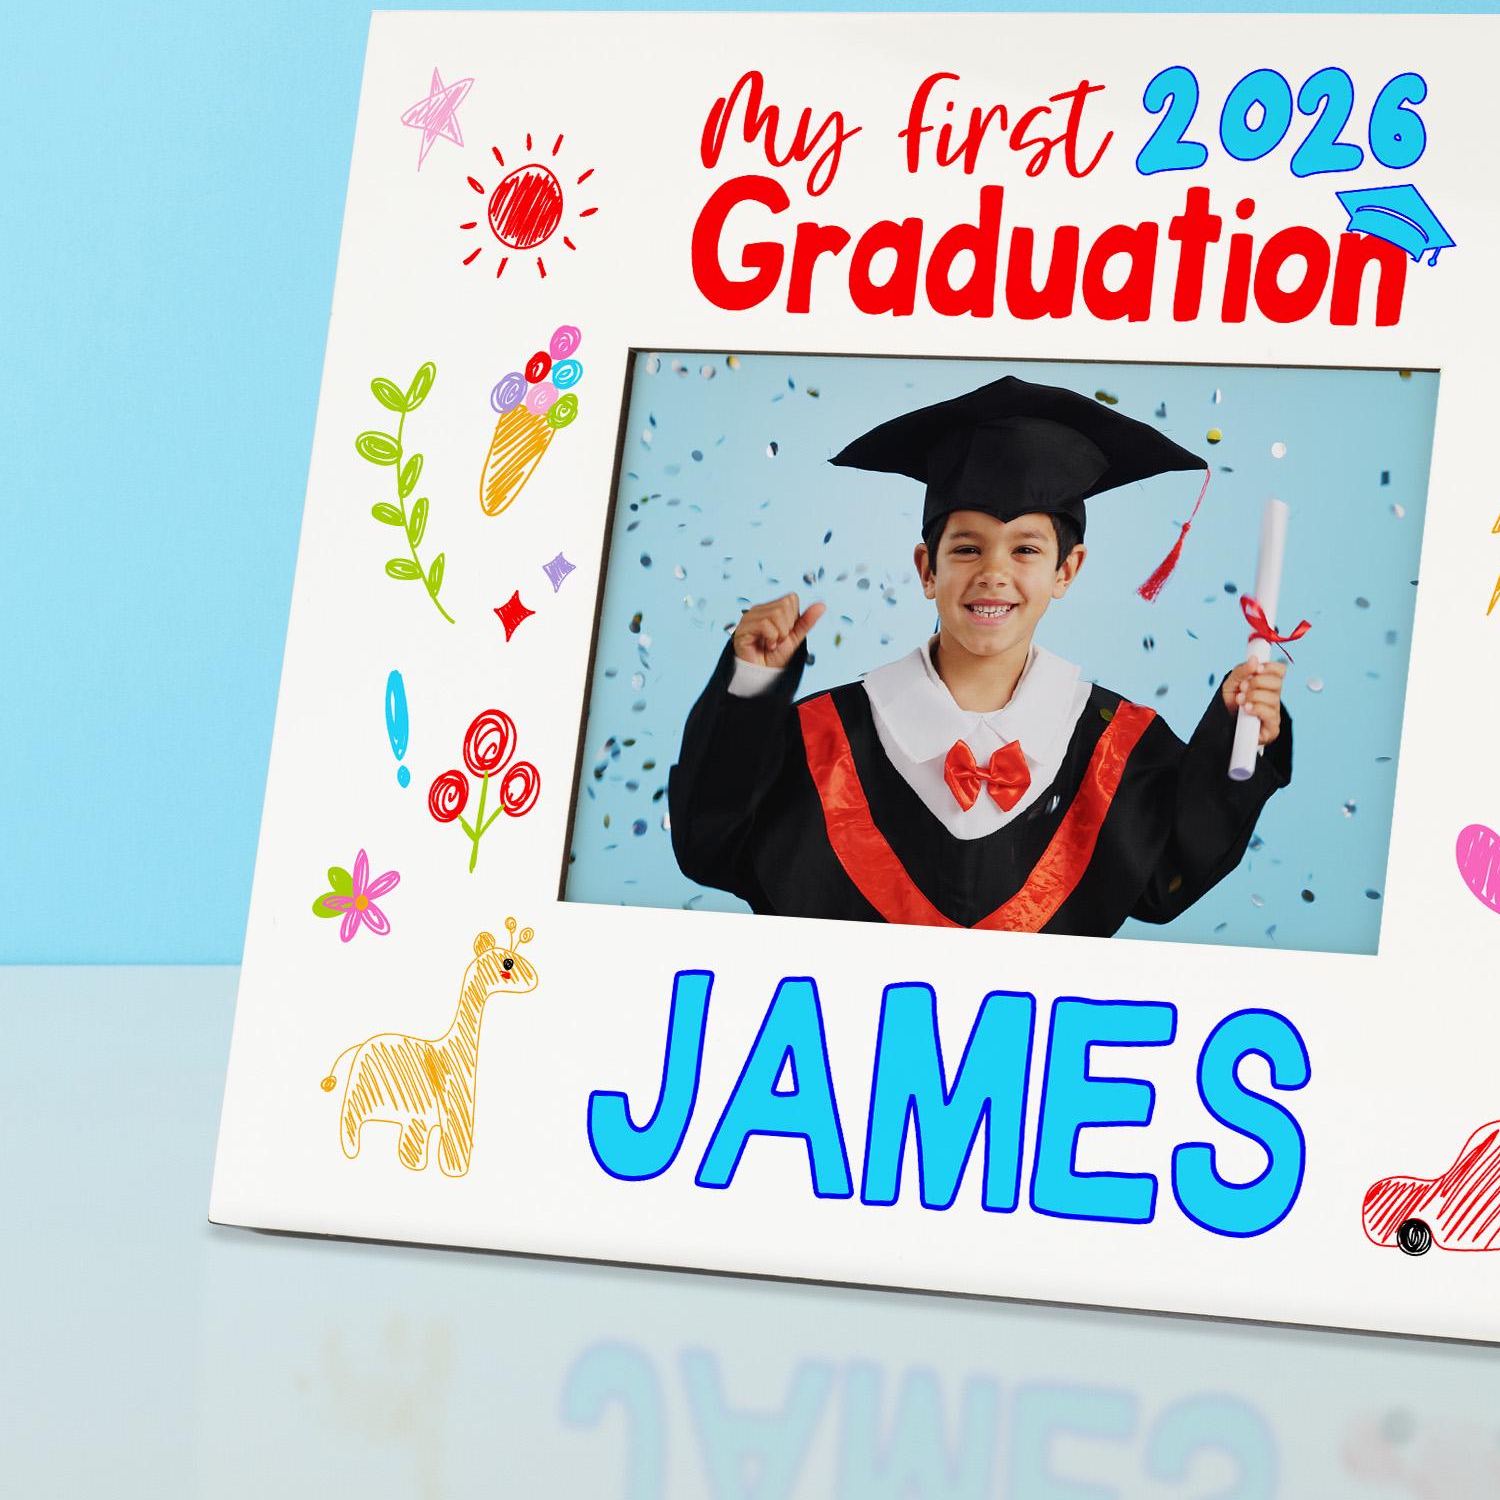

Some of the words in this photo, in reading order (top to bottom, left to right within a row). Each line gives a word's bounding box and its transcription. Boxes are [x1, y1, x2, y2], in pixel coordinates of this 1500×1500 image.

[699, 69, 862, 198] My
[896, 71, 1115, 180] first
[1134, 64, 1430, 180] 2026
[690, 173, 1410, 328] Graduation
[585, 967, 1313, 1240] JAMES
